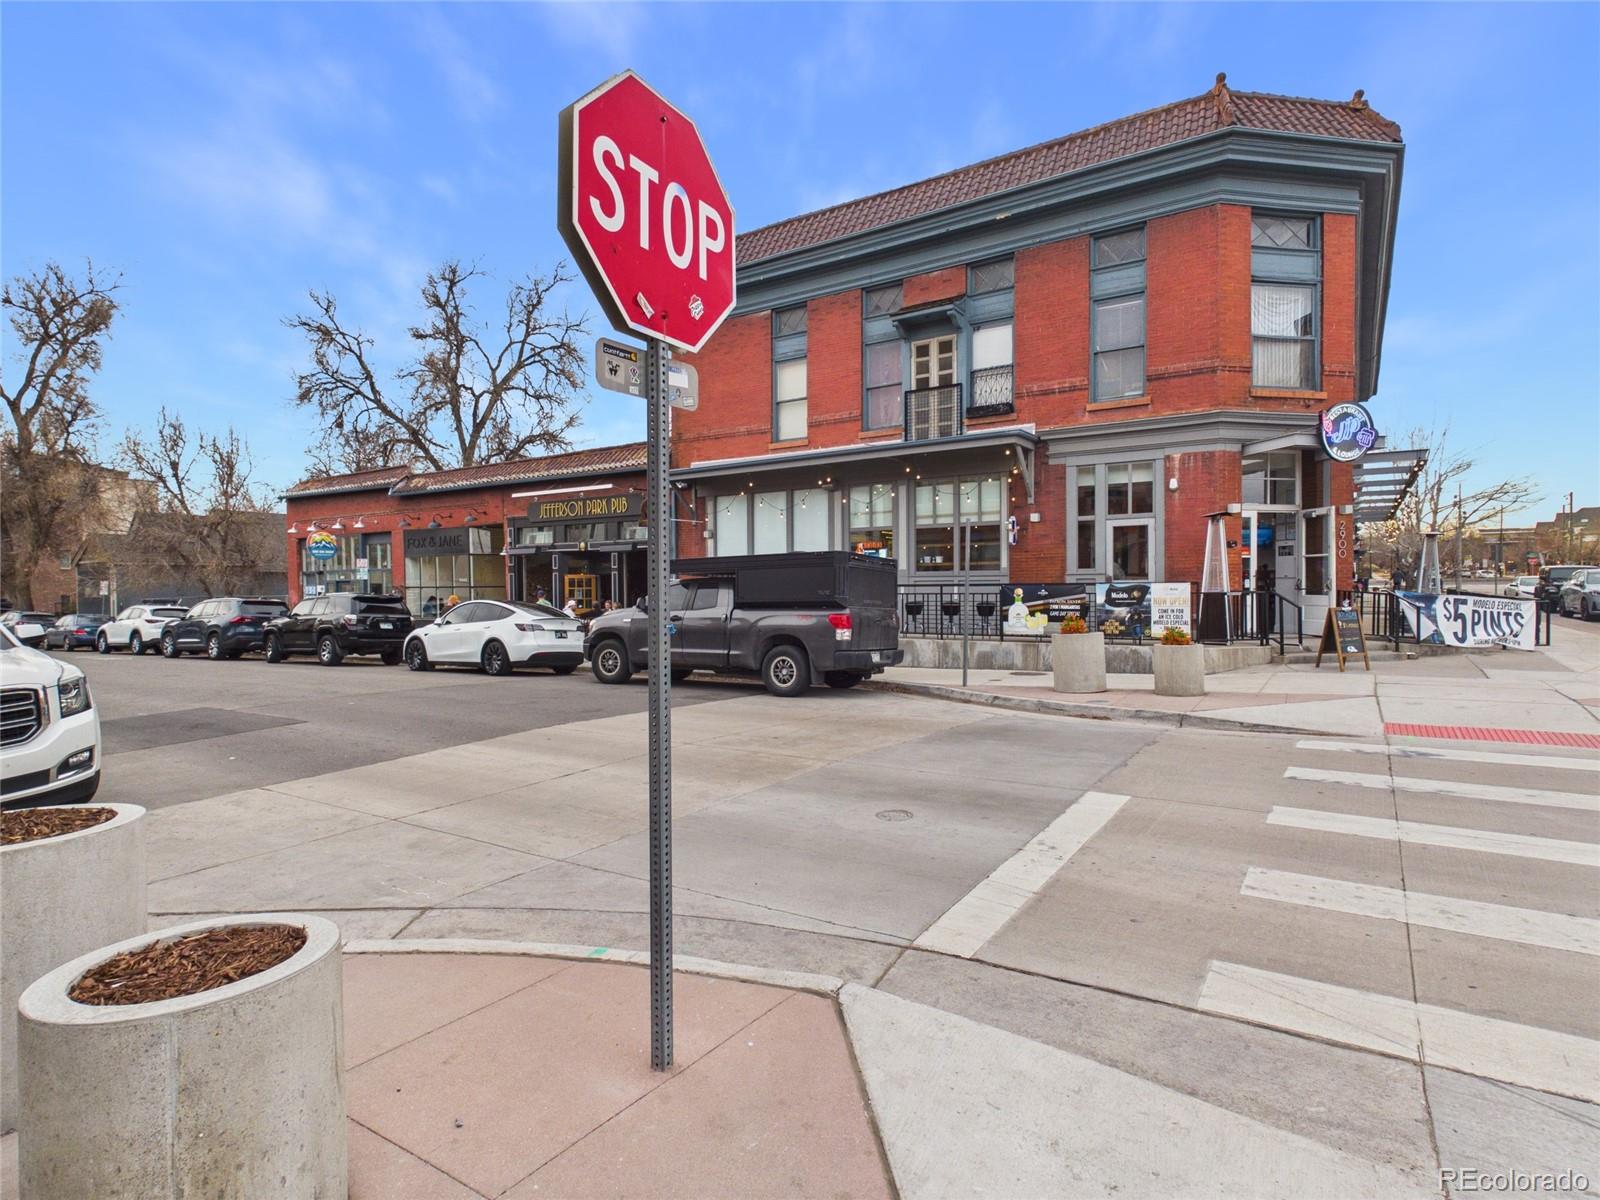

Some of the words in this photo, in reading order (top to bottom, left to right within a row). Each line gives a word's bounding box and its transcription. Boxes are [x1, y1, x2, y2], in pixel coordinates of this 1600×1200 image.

[589, 135, 725, 281] STOP
[1329, 407, 1366, 421] RESTAURANT
[1337, 447, 1361, 458] LOUNGE
[540, 501, 584, 518] JEFFERSON
[586, 498, 608, 516] PARK
[611, 496, 628, 514] PUB
[407, 537, 426, 549] FOX
[429, 536, 436, 548] &
[438, 534, 464, 548] JANE
[1338, 520, 1347, 558] 2900
[1111, 591, 1129, 599] Modelo
[1473, 599, 1496, 610] MODELO
[1497, 600, 1522, 611] ESPECIAL
[1443, 598, 1468, 643] $5
[1471, 609, 1524, 638] PINTS
